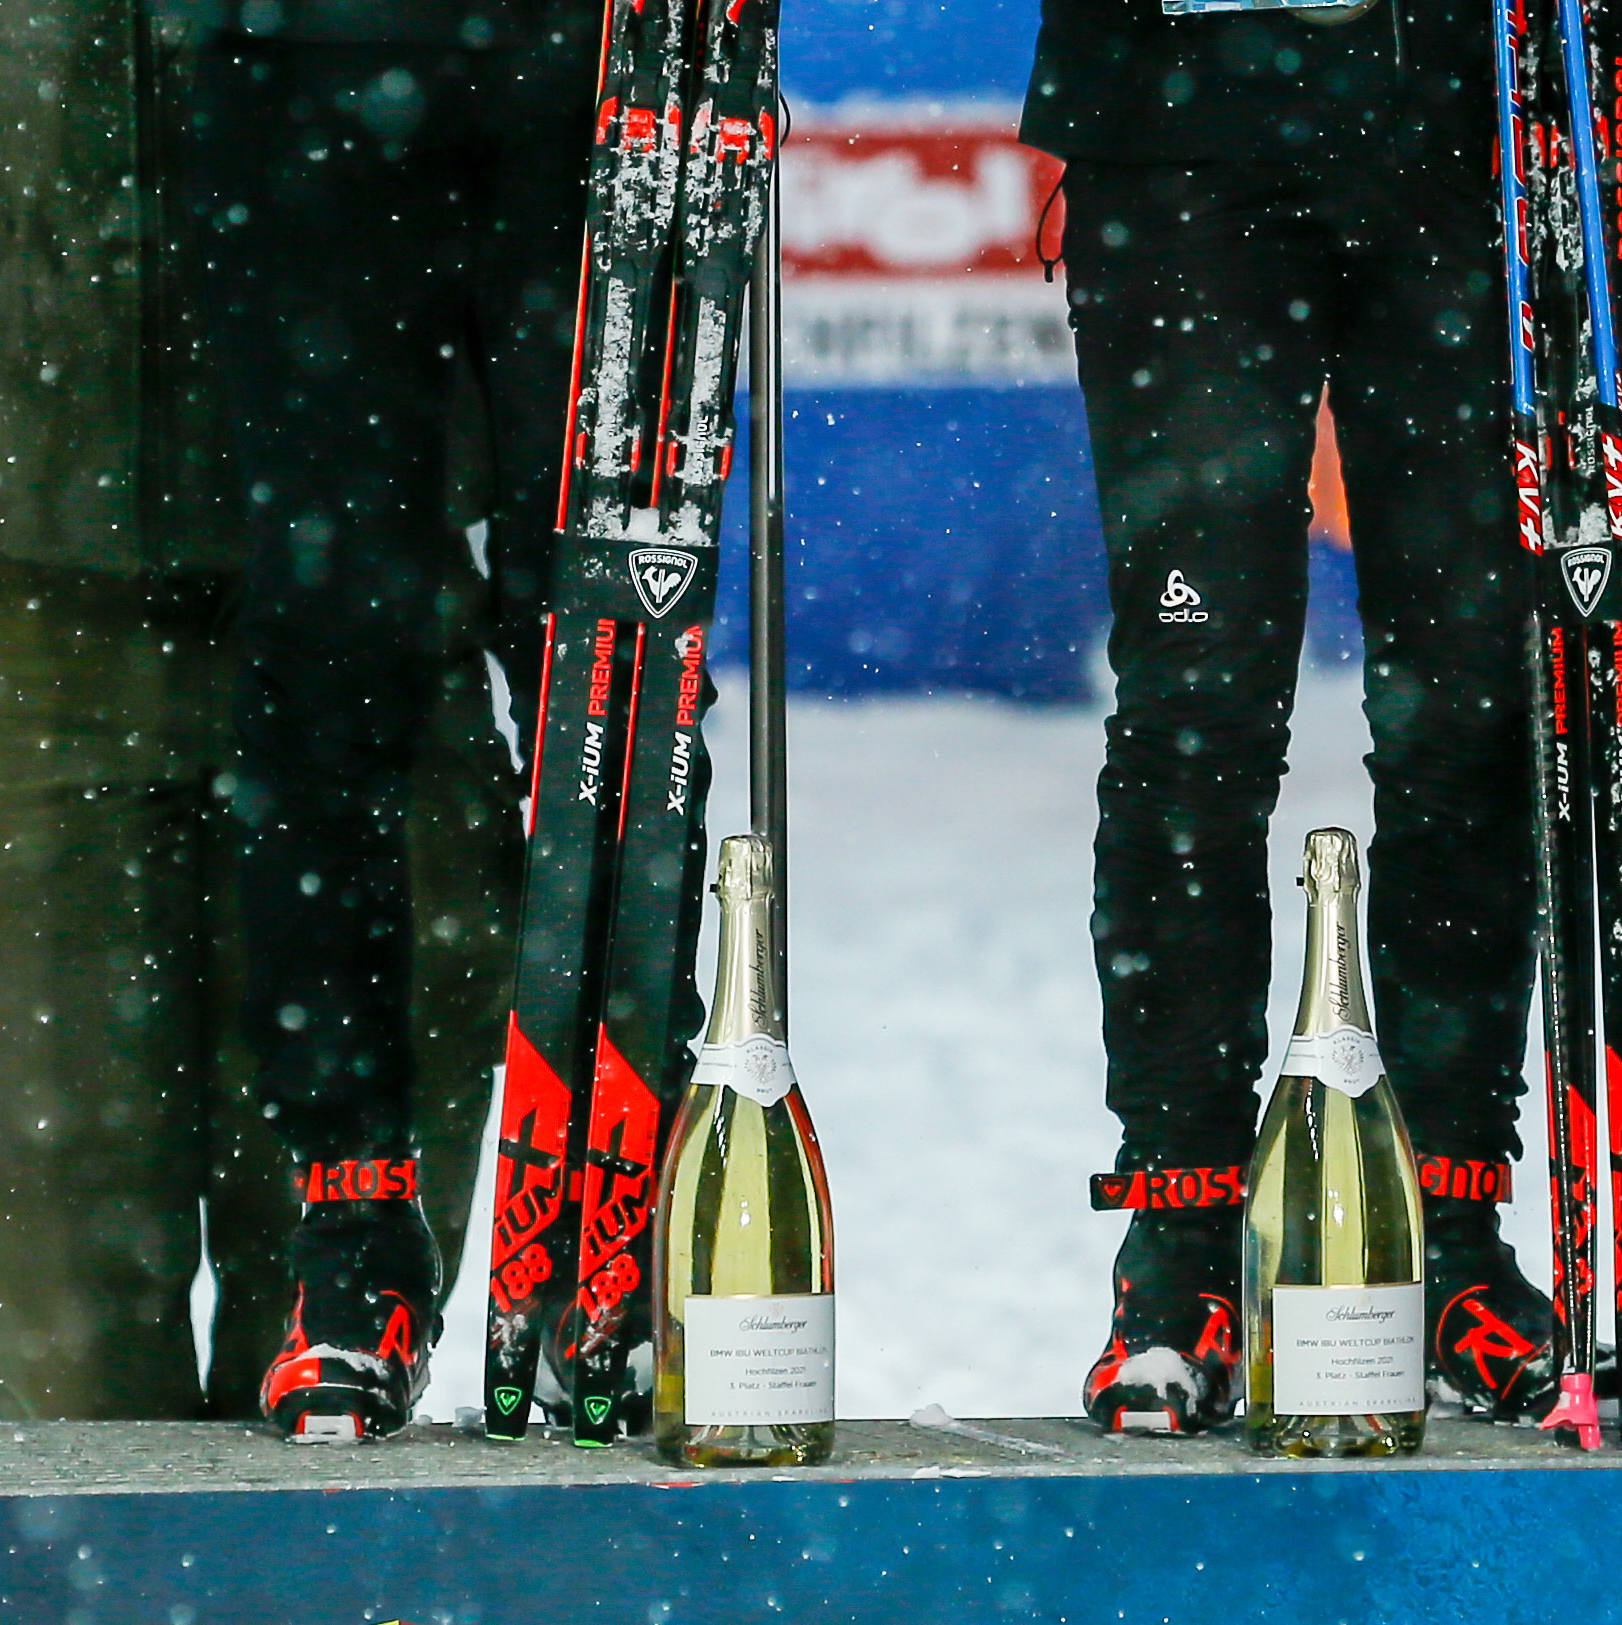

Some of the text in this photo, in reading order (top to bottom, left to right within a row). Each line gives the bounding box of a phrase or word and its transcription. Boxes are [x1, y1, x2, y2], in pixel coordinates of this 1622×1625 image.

[1517, 442, 1542, 552] KV+
[638, 554, 687, 569] ROSSIGNOL
[1554, 628, 1564, 734] PREMIUM
[752, 929, 768, 1029] Schlumberger
[1329, 921, 1351, 1022] Schlumberger
[490, 1243, 551, 1312] 188
[578, 1253, 640, 1322] 188
[739, 1315, 808, 1334] Schlumberger
[1325, 1304, 1395, 1324] Schlumberger
